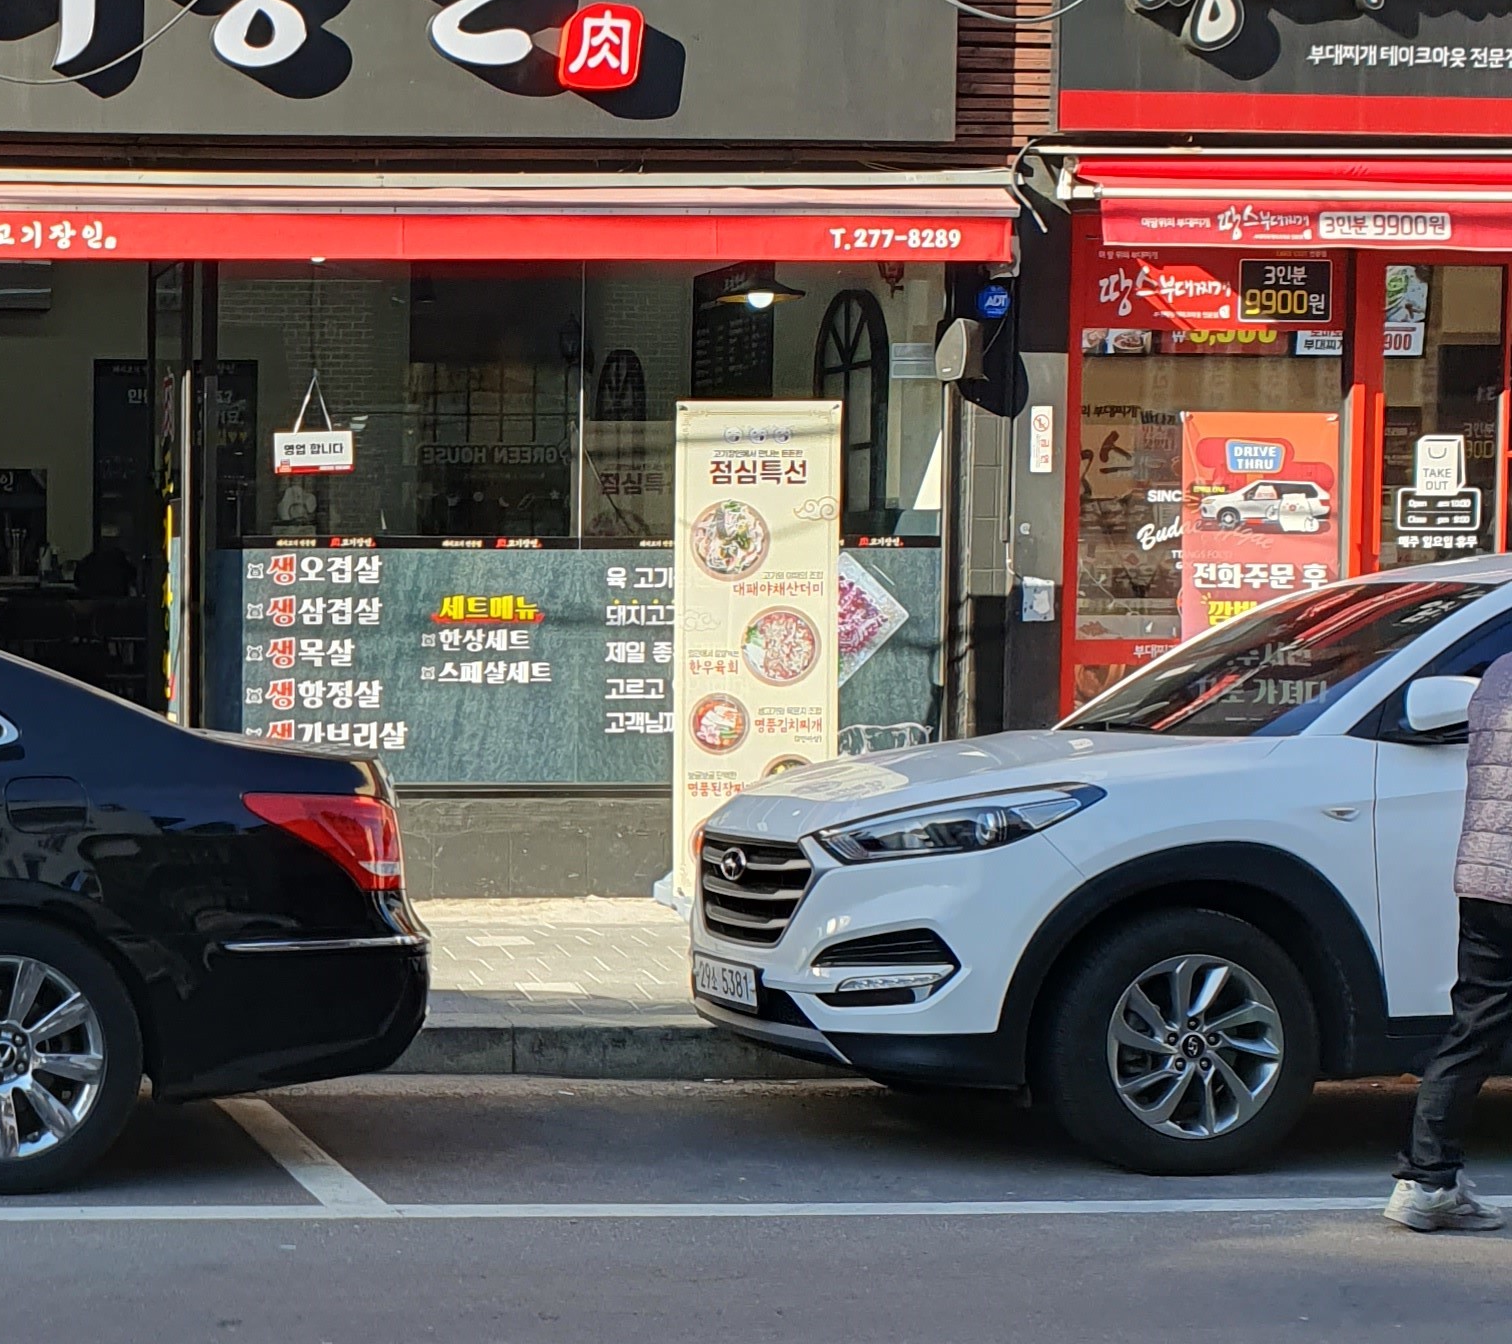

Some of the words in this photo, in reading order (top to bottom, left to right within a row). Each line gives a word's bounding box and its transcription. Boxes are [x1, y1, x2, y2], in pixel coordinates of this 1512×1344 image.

[1307, 45, 1378, 67] 부대찌개
[1379, 45, 1467, 69] 테이크아웃
[1324, 215, 1369, 235] 3인분
[1373, 214, 1445, 236] 9900원
[1263, 265, 1307, 286] 3인분
[984, 294, 1008, 308] ADT
[309, 442, 344, 455] 합니다
[1233, 446, 1277, 457] DRIVE
[709, 459, 808, 485] 점심특선
[1236, 458, 1274, 470] THRU
[1423, 467, 1452, 478] TAKE
[1147, 489, 1183, 503] SINC
[1425, 481, 1448, 491] OUT
[266, 553, 383, 586] 생오겹살
[606, 567, 627, 589] 육
[1192, 562, 1295, 589] 전화주문
[1301, 562, 1329, 588] 후
[732, 580, 824, 597] 대패야채산더미
[266, 595, 383, 627] 생삼겹살
[439, 595, 539, 621] 세트메뉴
[438, 628, 531, 652] 한상세트
[266, 637, 355, 669] 생목살
[605, 640, 646, 663] 제일
[438, 661, 552, 684] 스페샬세트
[689, 659, 739, 676] 한우육회
[265, 677, 383, 711] 생항정살
[604, 679, 666, 700] 고르고
[754, 717, 823, 734] 명품김치찌개
[687, 781, 745, 797] 명품된장찌
[721, 967, 750, 1001] 5381
